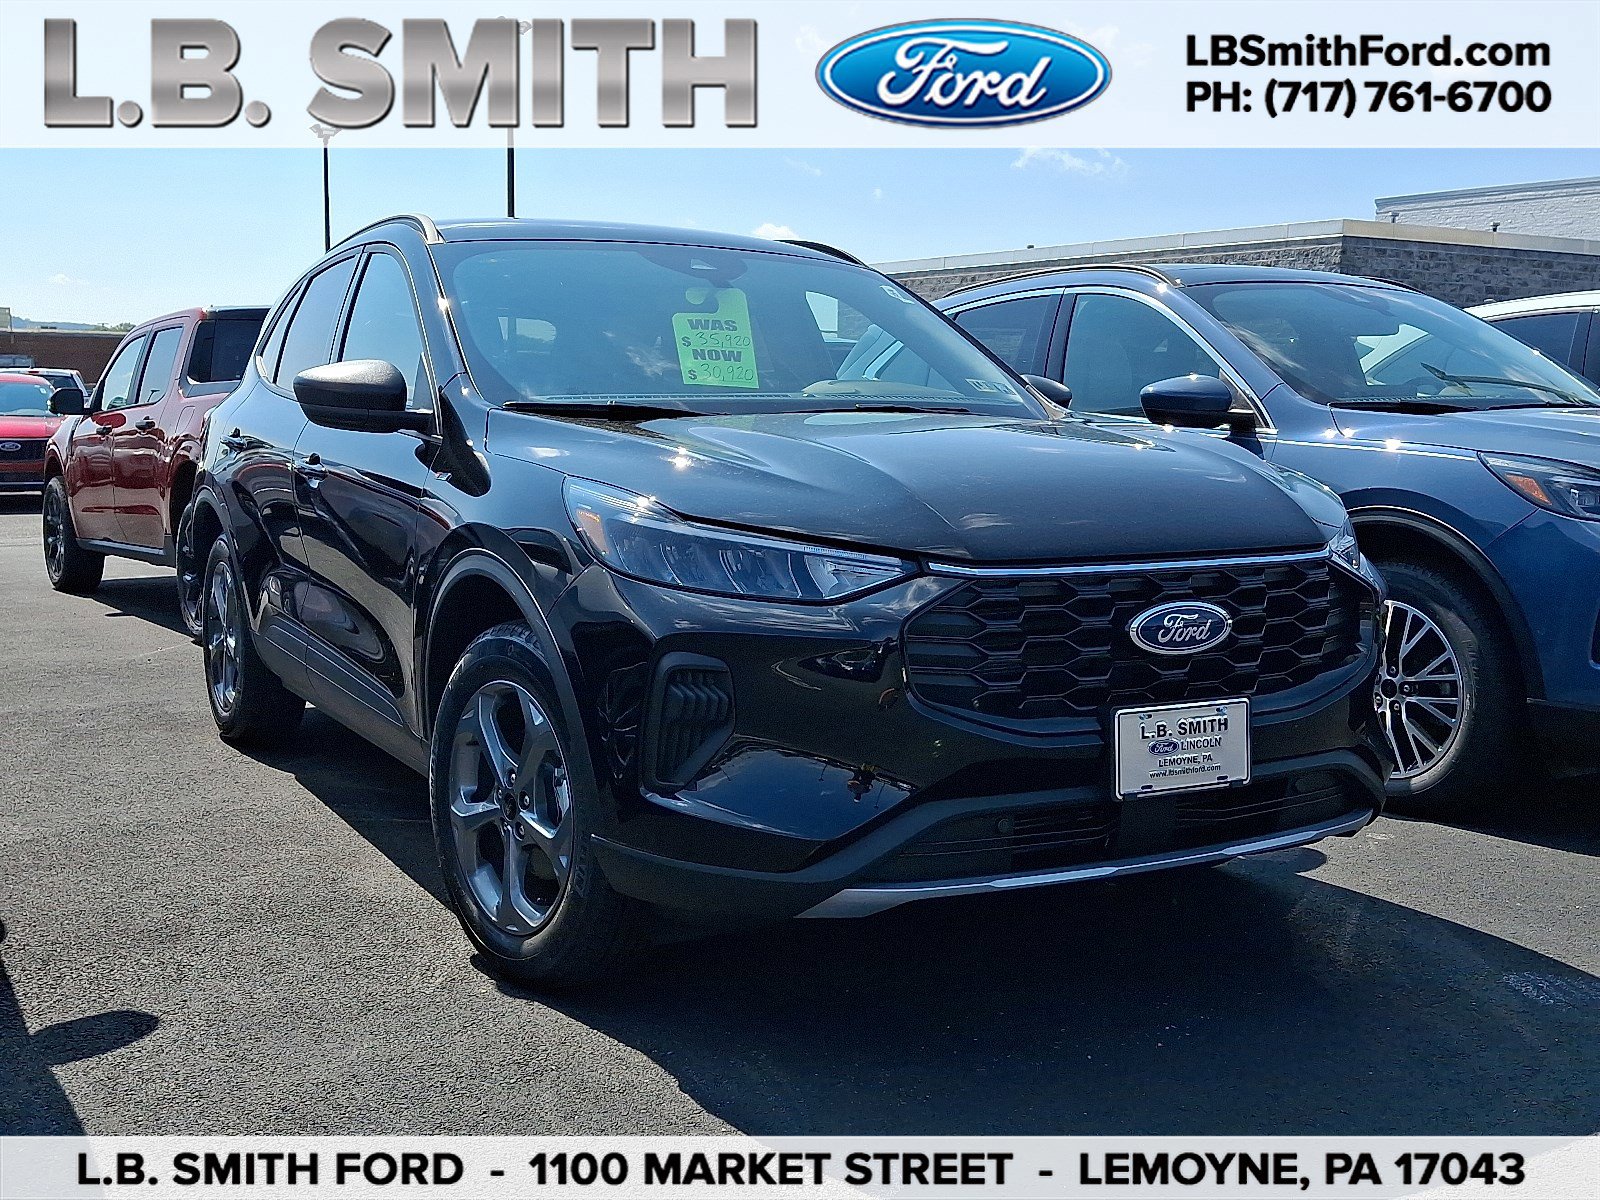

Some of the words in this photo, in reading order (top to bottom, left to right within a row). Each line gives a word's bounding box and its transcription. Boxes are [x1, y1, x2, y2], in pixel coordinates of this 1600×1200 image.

[687, 319, 738, 332] WAS
[696, 331, 751, 348] 35,920
[691, 349, 742, 362] NOW
[701, 363, 754, 381] 30,920
[1158, 613, 1212, 643] Ford
[1140, 722, 1173, 740] L.B.
[1177, 717, 1229, 736] SMITH
[1180, 736, 1222, 751] LINCOLN
[1158, 755, 1201, 768] LEMOYNE,
[1202, 753, 1213, 763] PA
